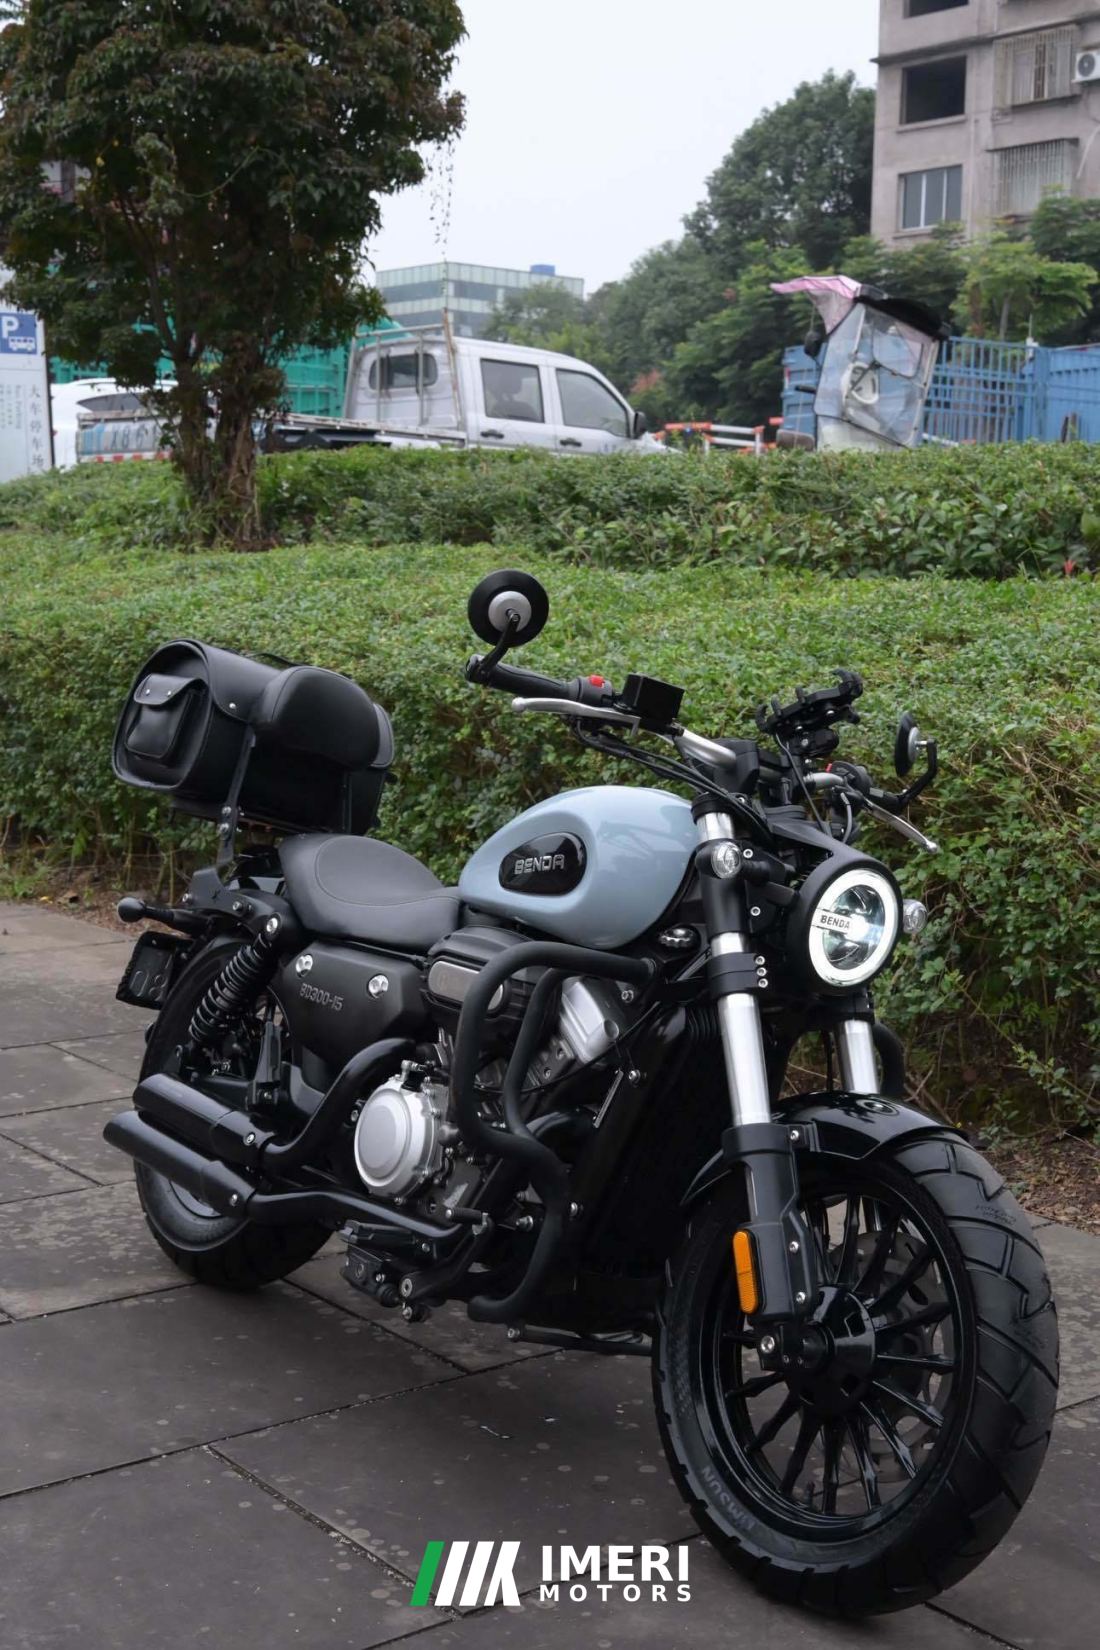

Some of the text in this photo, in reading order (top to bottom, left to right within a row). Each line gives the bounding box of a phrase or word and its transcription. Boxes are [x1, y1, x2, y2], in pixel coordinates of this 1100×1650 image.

[1, 316, 19, 338] P
[514, 854, 565, 875] BENDA
[820, 914, 851, 930] BENDA
[300, 983, 344, 1011] BD300-15
